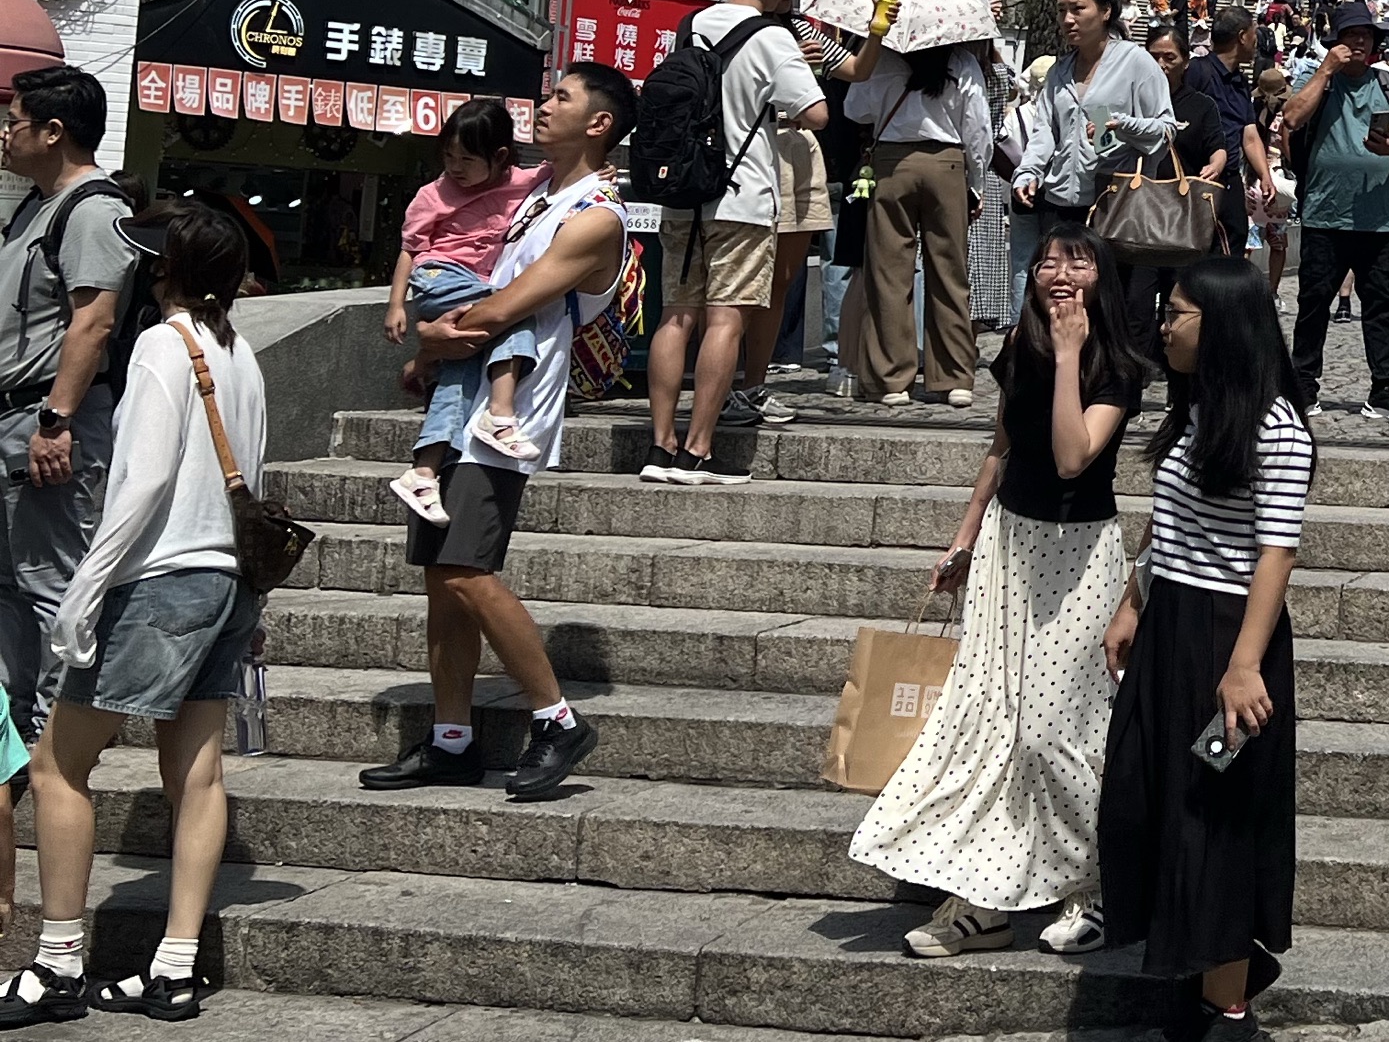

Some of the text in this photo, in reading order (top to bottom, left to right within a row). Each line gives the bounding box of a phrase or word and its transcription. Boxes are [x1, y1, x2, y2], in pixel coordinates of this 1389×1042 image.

[246, 31, 303, 47] CHRONOS
[325, 20, 488, 77] 手錶專賣
[572, 17, 598, 63] 雪糕
[614, 22, 639, 72] 燒烤
[139, 70, 531, 140] 全場品牌手錶低至6起
